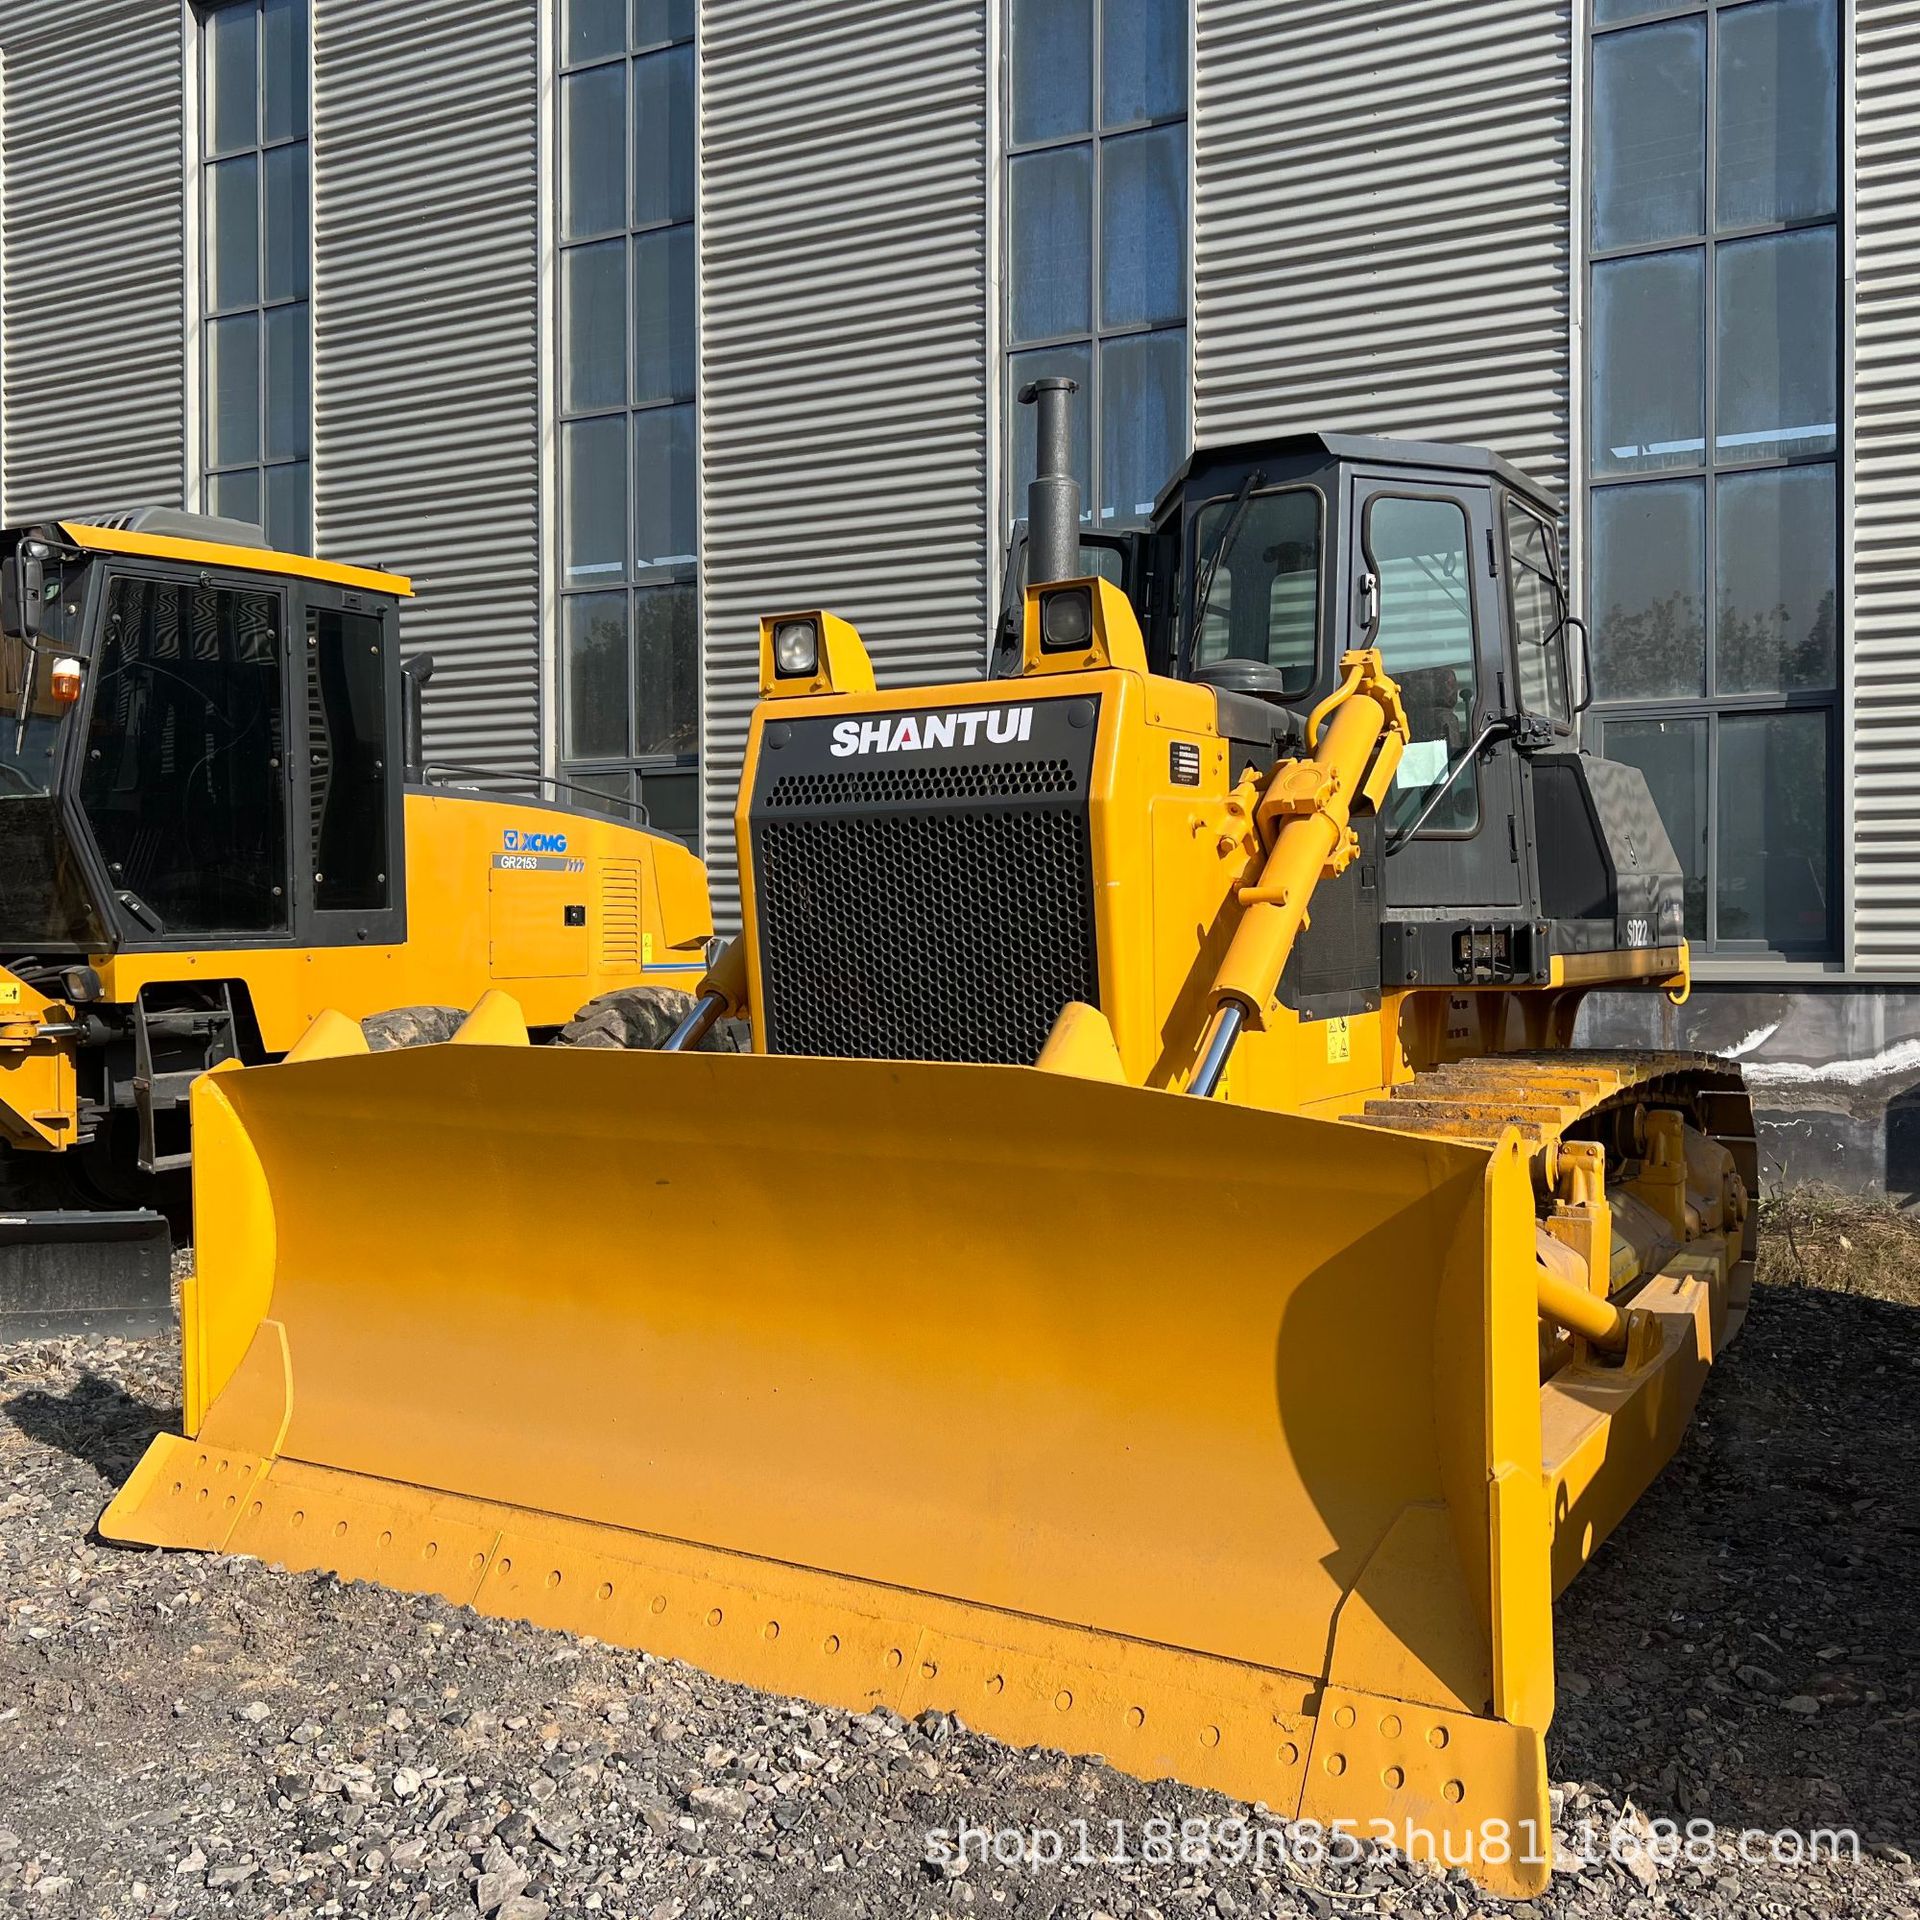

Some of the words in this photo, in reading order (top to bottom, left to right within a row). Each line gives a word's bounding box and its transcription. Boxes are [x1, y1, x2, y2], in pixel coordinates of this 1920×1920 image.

[830, 707, 1034, 757] SHANTUI
[521, 832, 567, 853] XCMG
[1627, 919, 1648, 947] SD22
